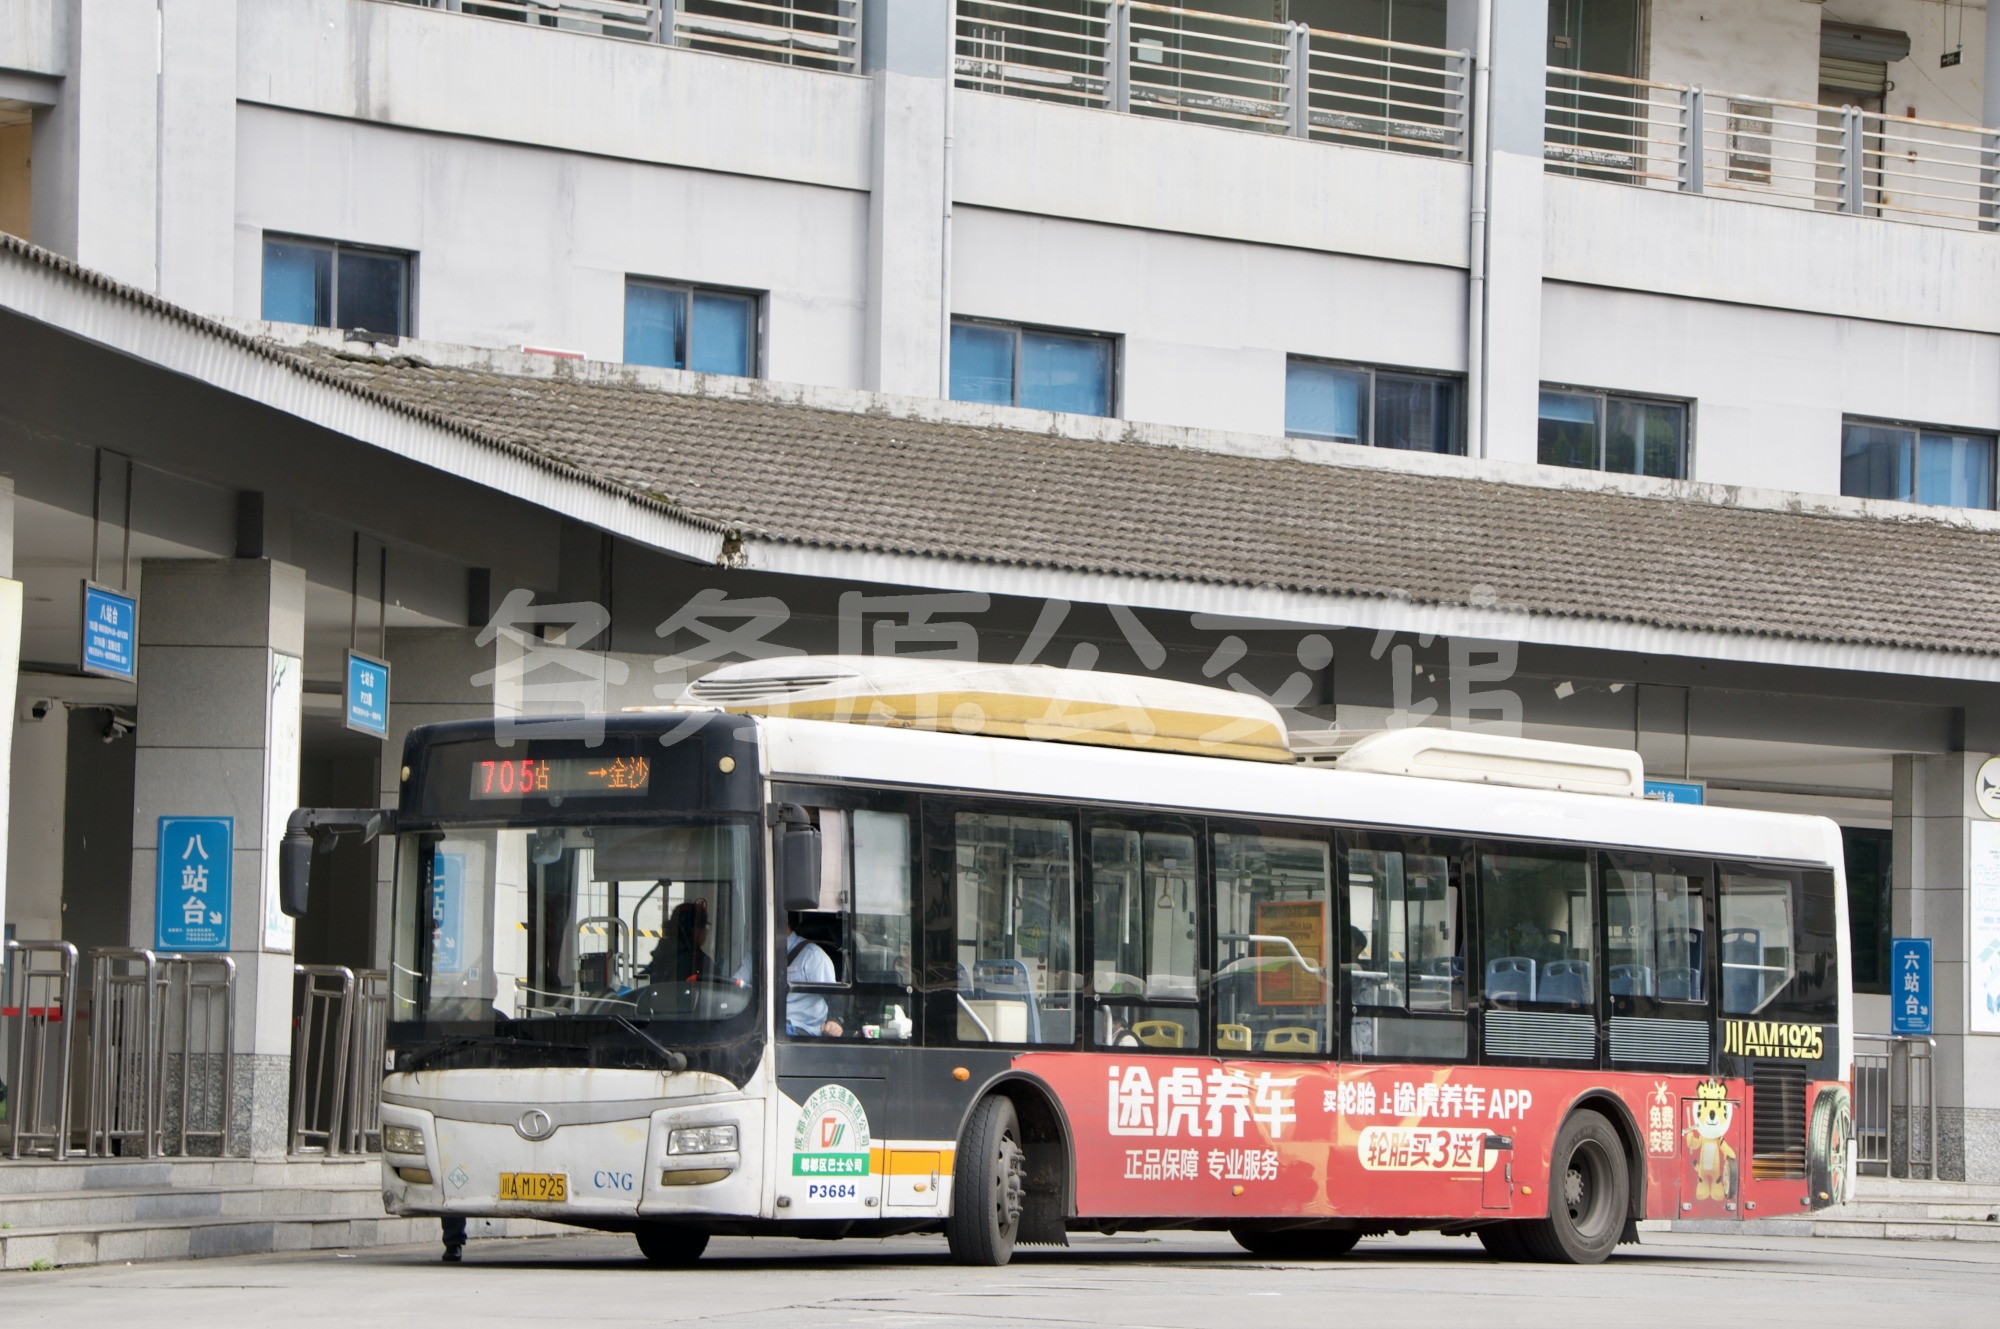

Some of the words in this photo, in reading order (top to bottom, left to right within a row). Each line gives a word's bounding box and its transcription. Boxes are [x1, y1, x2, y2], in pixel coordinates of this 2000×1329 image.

[100, 604, 118, 626] 八站台
[360, 670, 375, 689] 七站台
[608, 756, 649, 789] 金沙
[182, 834, 209, 925] 八站台
[1904, 950, 1920, 1015] 六站台
[1724, 1020, 1823, 1059] 川AM1925
[794, 1086, 869, 1150] 成都市公共交通集团公司
[1108, 1066, 1297, 1138] 途虎养车
[1124, 1149, 1199, 1180] 正品保障
[1207, 1149, 1279, 1181] 专业服务
[1367, 1130, 1487, 1168] 轮胎买3送1
[594, 1171, 633, 1191] CNG
[809, 1185, 856, 1198] P3684
